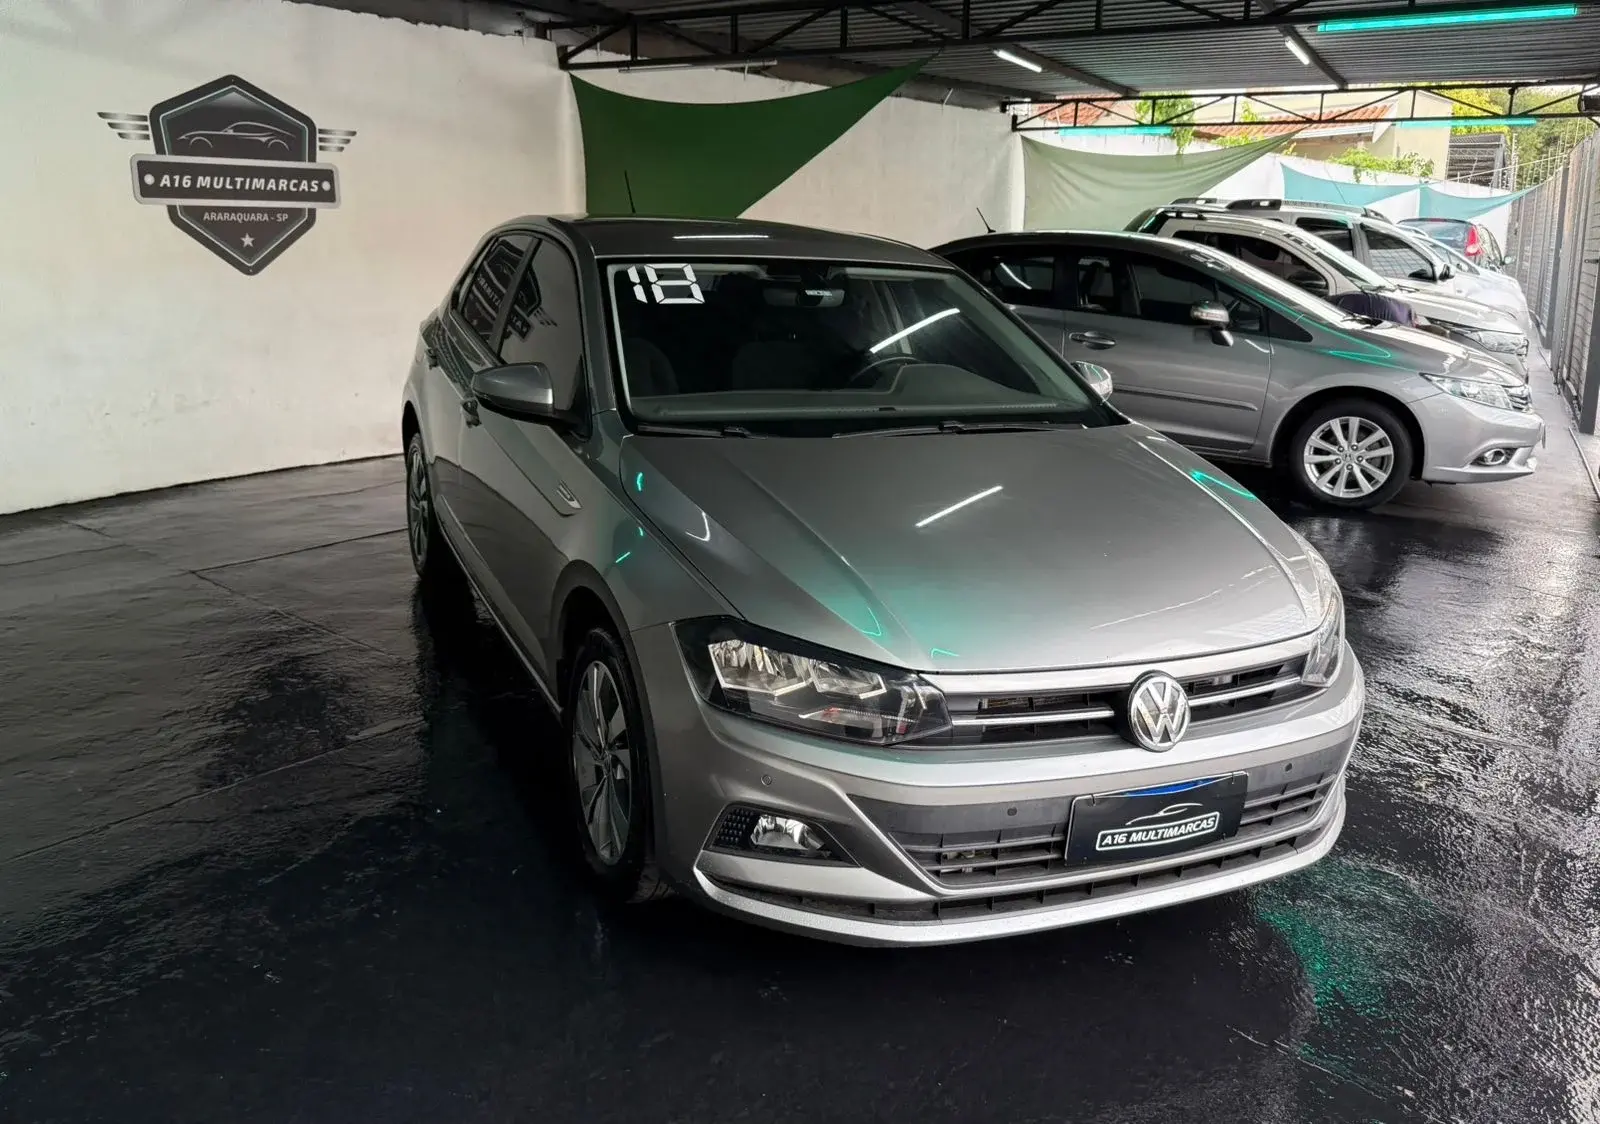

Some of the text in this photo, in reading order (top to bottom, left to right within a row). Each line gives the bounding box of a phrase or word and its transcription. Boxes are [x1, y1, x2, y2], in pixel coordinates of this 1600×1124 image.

[160, 174, 319, 193] A16 MULTIMARCAS
[203, 212, 269, 223] ARARAQUARA
[276, 213, 289, 222] SP
[627, 263, 705, 304] 18
[1102, 817, 1216, 846] A16 MULTIMARCAS
